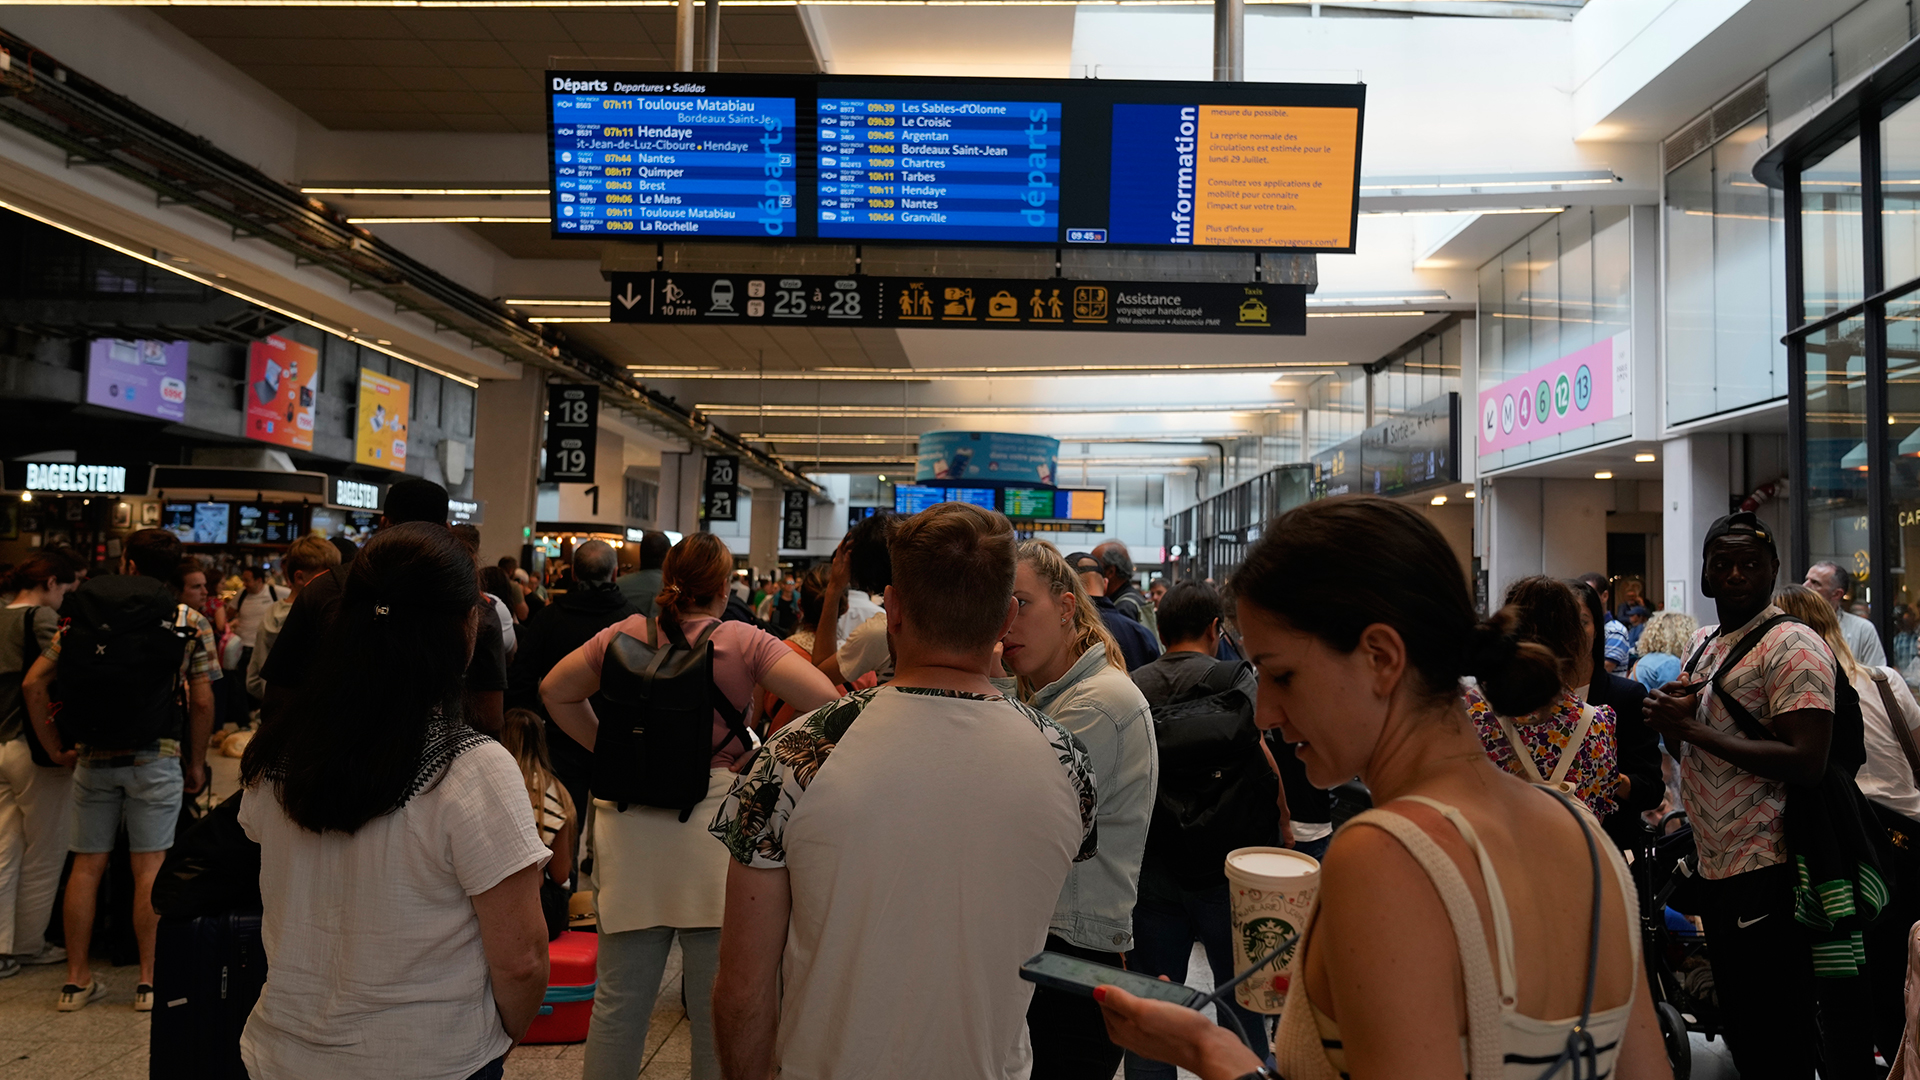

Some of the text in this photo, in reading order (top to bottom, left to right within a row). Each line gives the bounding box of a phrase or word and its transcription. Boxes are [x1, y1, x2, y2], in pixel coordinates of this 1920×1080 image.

[553, 78, 706, 94] Départs Departures Salidas
[603, 99, 755, 111] 07h11 Toulouse Matabiau
[868, 104, 894, 112] 09h39
[902, 104, 1007, 114] Les Sables-d'Olonne
[678, 113, 726, 123] Bordeaux
[868, 117, 894, 126] 09h39
[902, 117, 952, 127] Le Croisic
[604, 127, 692, 140] 07h11 Hendaye
[868, 131, 894, 140] 09h45
[902, 131, 949, 142] Argentan
[704, 141, 748, 153] Hendaye
[868, 145, 894, 153] 10h04
[902, 145, 1008, 156] Bordeaux Saint-Jean
[605, 154, 675, 163] 07h44 Nantes
[869, 158, 894, 167] 10h09
[902, 158, 946, 168] Chartres
[1242, 156, 1269, 164] Juillet.
[605, 167, 684, 178] 08h17 Quimper
[1020, 108, 1052, 227] départs
[758, 117, 782, 235] départs
[868, 172, 894, 181] 10h11
[901, 172, 936, 182] Tarbes
[1170, 107, 1195, 244] information
[606, 181, 666, 191] 08h43 Brest
[868, 186, 894, 195] 10h11
[1264, 181, 1310, 189] applications
[902, 185, 946, 197] Hendaye
[606, 194, 681, 205] 09h06 Le Mans
[868, 199, 894, 208] 10h39
[902, 199, 939, 209] Nantes
[1207, 202, 1238, 210] l'impact
[606, 207, 735, 219] 09h11 Toulouse Matabiau
[868, 213, 894, 222] 10h54
[901, 213, 947, 223] Granville
[607, 221, 699, 232] 09h30 La Rochelle
[1224, 225, 1249, 233] d'infos
[910, 282, 924, 290] WC
[774, 288, 861, 315] 25 à 28
[1116, 292, 1181, 306] Assistance
[662, 306, 697, 316] 10 min
[1116, 306, 1202, 317] voyageur handicapé
[1116, 317, 1132, 325] PRM
[1205, 318, 1221, 326] PMR
[1504, 375, 1588, 424] M 4 6 12 13
[559, 401, 588, 423] 18
[1390, 421, 1408, 444] Sortie
[557, 450, 585, 472] 19
[25, 462, 126, 493] BAGELSTEIN
[712, 467, 732, 482] 20
[336, 480, 379, 509] BAGELSTEIN
[584, 485, 599, 516] 1
[711, 499, 731, 514] 21
